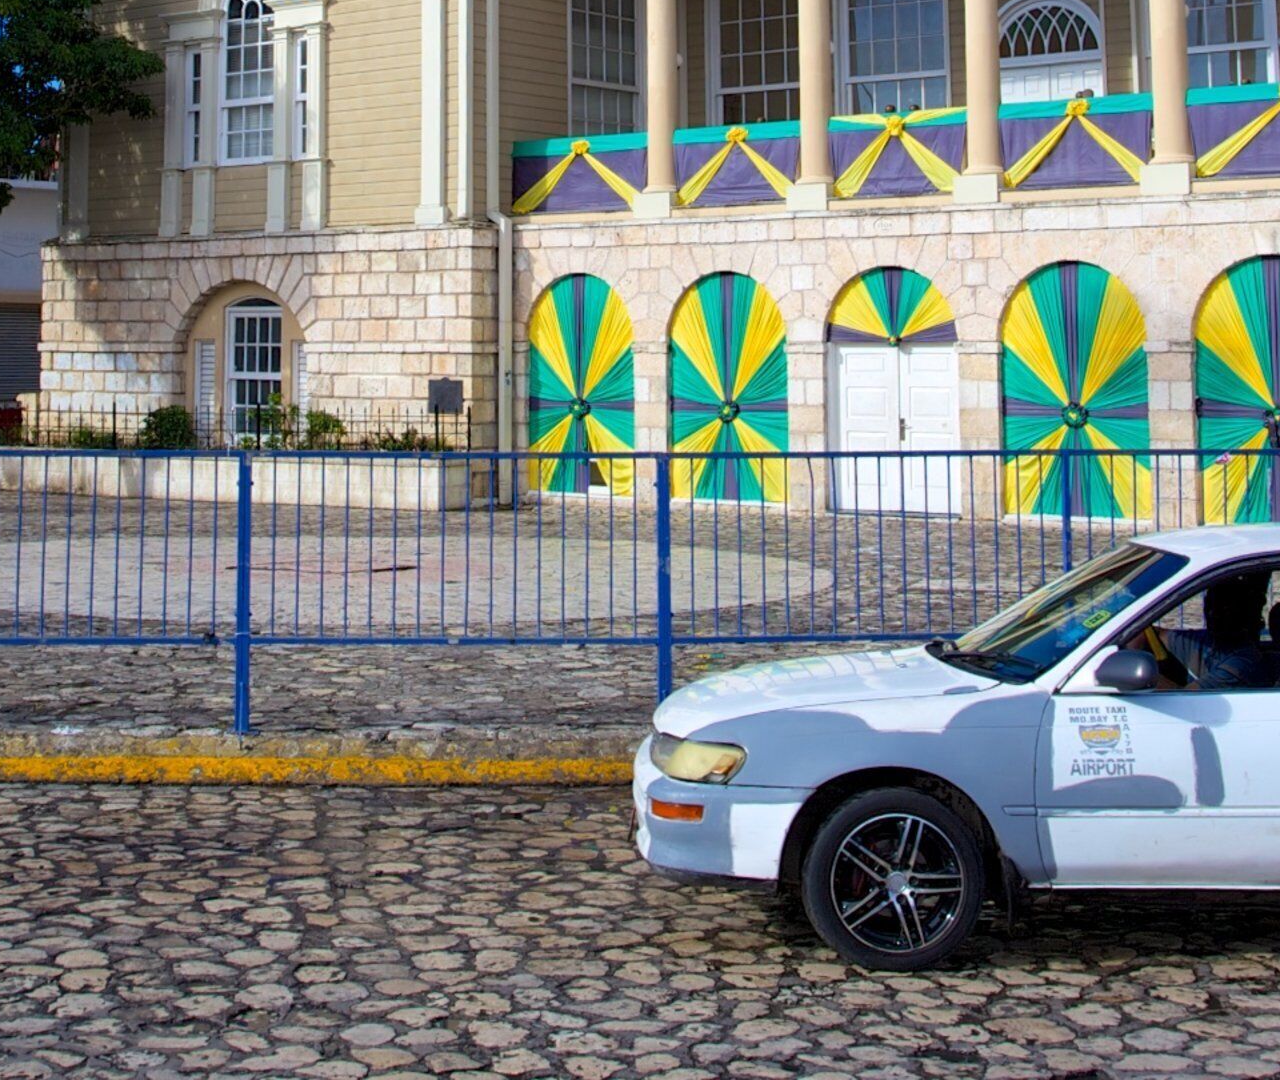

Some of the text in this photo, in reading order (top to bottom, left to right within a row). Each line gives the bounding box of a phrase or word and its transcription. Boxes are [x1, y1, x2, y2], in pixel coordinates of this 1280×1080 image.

[1068, 706, 1127, 715] ROUTE TAXI
[1070, 758, 1135, 776] AIRPORT
